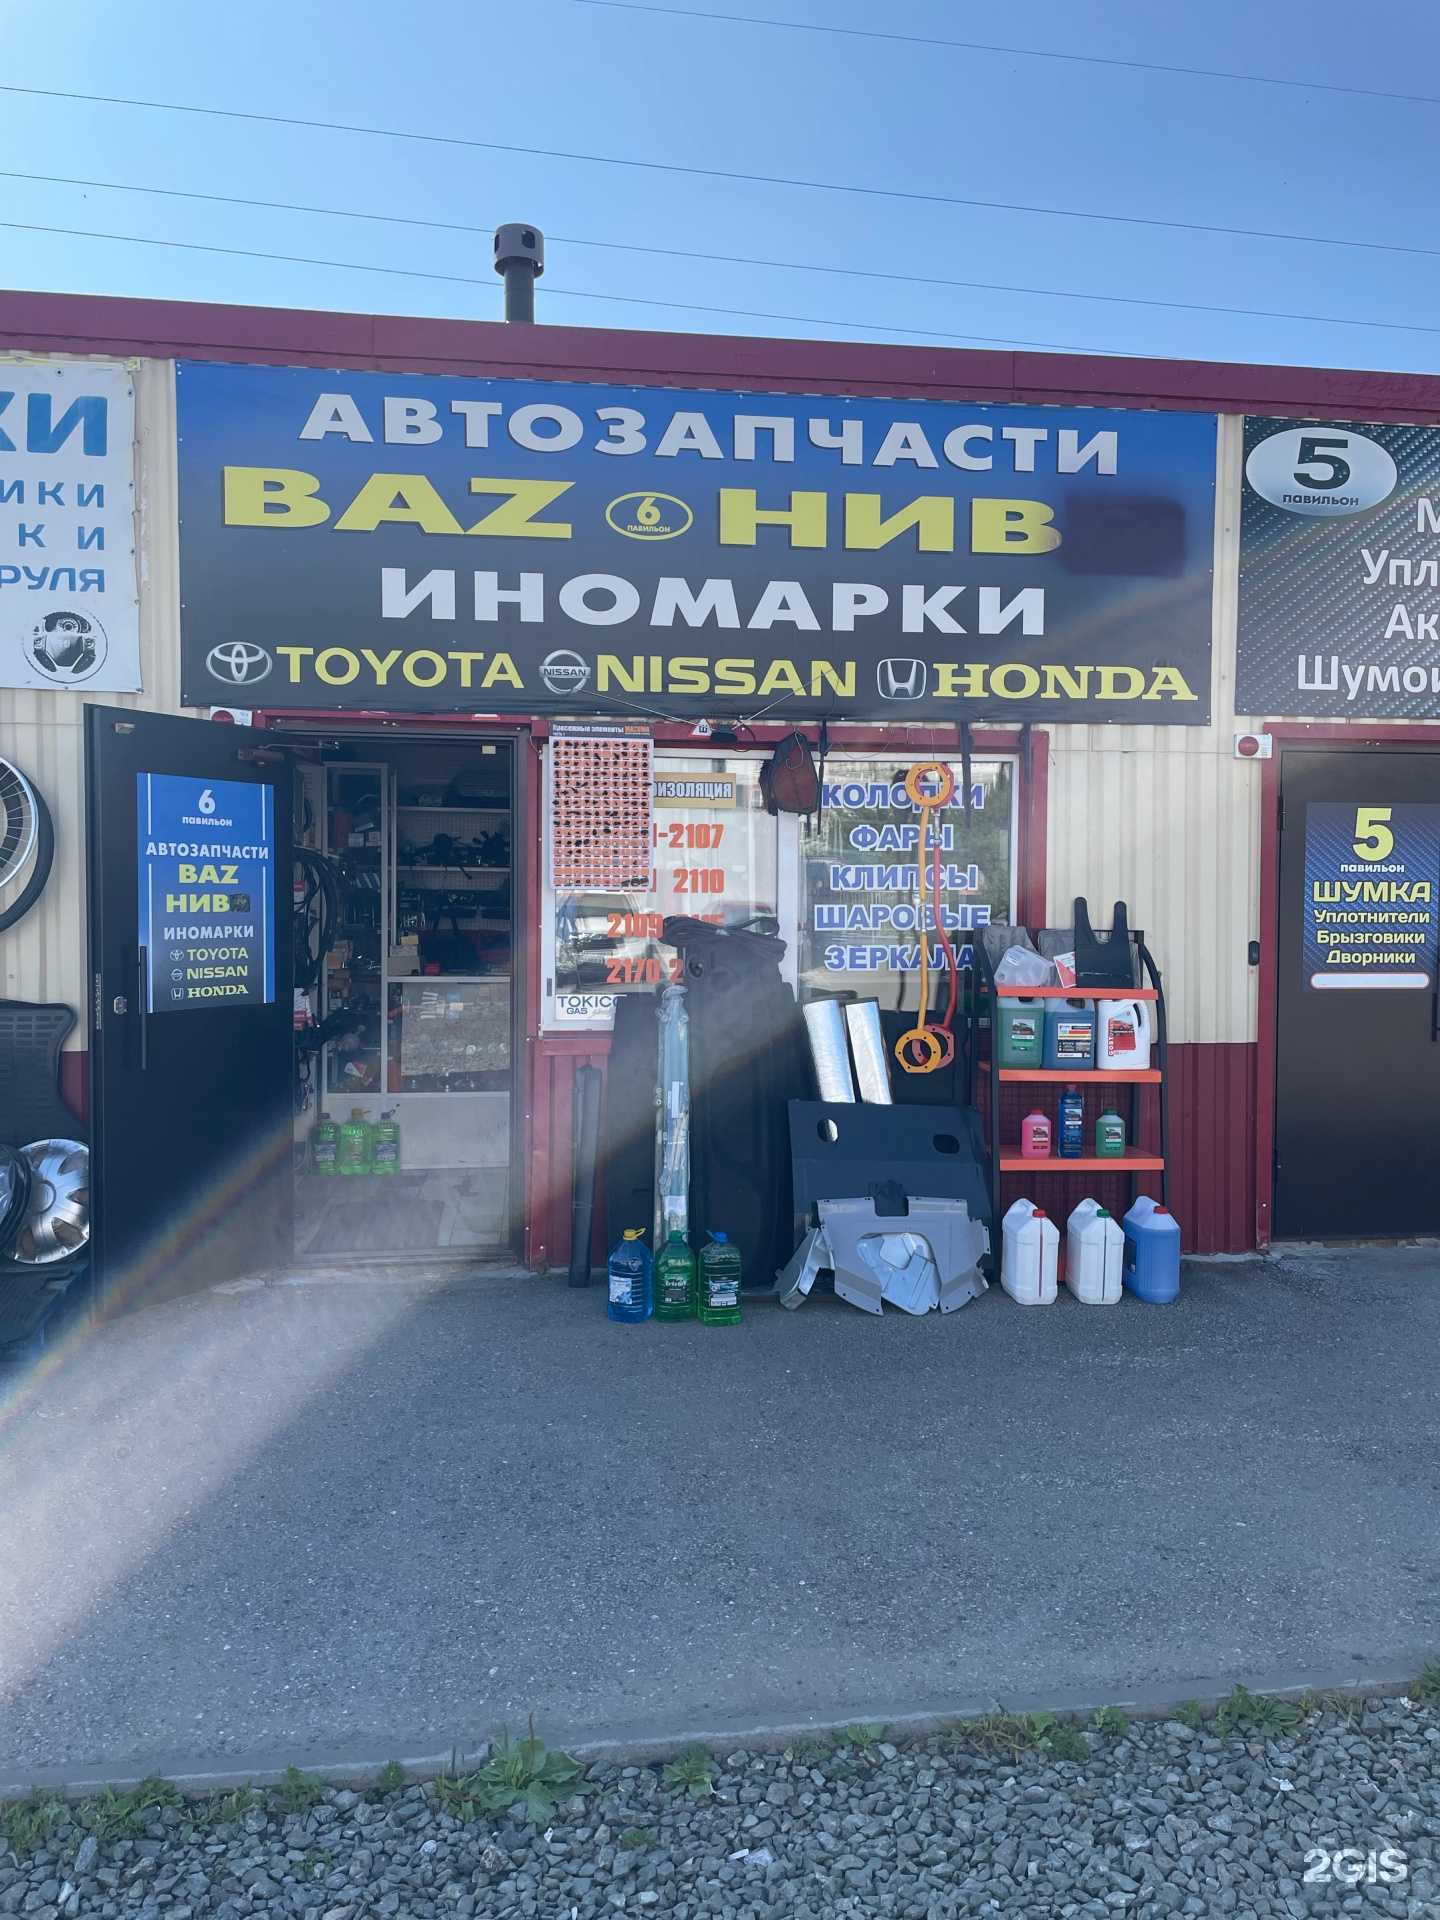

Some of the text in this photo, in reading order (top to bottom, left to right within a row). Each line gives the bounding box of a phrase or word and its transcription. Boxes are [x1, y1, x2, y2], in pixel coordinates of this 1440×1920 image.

[0, 391, 108, 456] И
[299, 393, 1118, 475] АВТОЗАПЧАСТИ
[1293, 437, 1350, 489] 5
[223, 466, 576, 539] BAZ
[637, 496, 660, 526] 6
[1282, 493, 1359, 506] павильон
[718, 487, 1062, 554] НИВ
[1361, 549, 1438, 588] Упл
[381, 567, 1045, 635] ИНОМАРКИ
[276, 646, 1198, 701] TOYOTA NISSAN NISSAN HONDA
[199, 789, 216, 815] 6
[182, 815, 233, 827] павильон
[1352, 807, 1394, 861] 5
[146, 842, 269, 859] АВТОЗАПЧАСТИ
[850, 824, 953, 851] ФАРЫ
[179, 863, 239, 884] BAZ
[673, 868, 725, 894] 2110
[830, 864, 978, 890] КЛИПСЫ
[1340, 863, 1405, 873] павильон
[166, 894, 230, 913] НИВ
[1313, 881, 1431, 903] ШУМКА
[814, 904, 991, 931] ШАРОВЫЕ
[1314, 909, 1430, 924] Уплотнители
[164, 926, 254, 941] ИНОМАРКИ
[1317, 930, 1425, 944] Брызговики
[187, 948, 248, 961] TOYOTA
[824, 944, 974, 971] ЗЕРКАЛА
[1326, 950, 1416, 966] Дворники
[187, 966, 248, 980] NISSAN
[187, 985, 248, 998] HONDA
